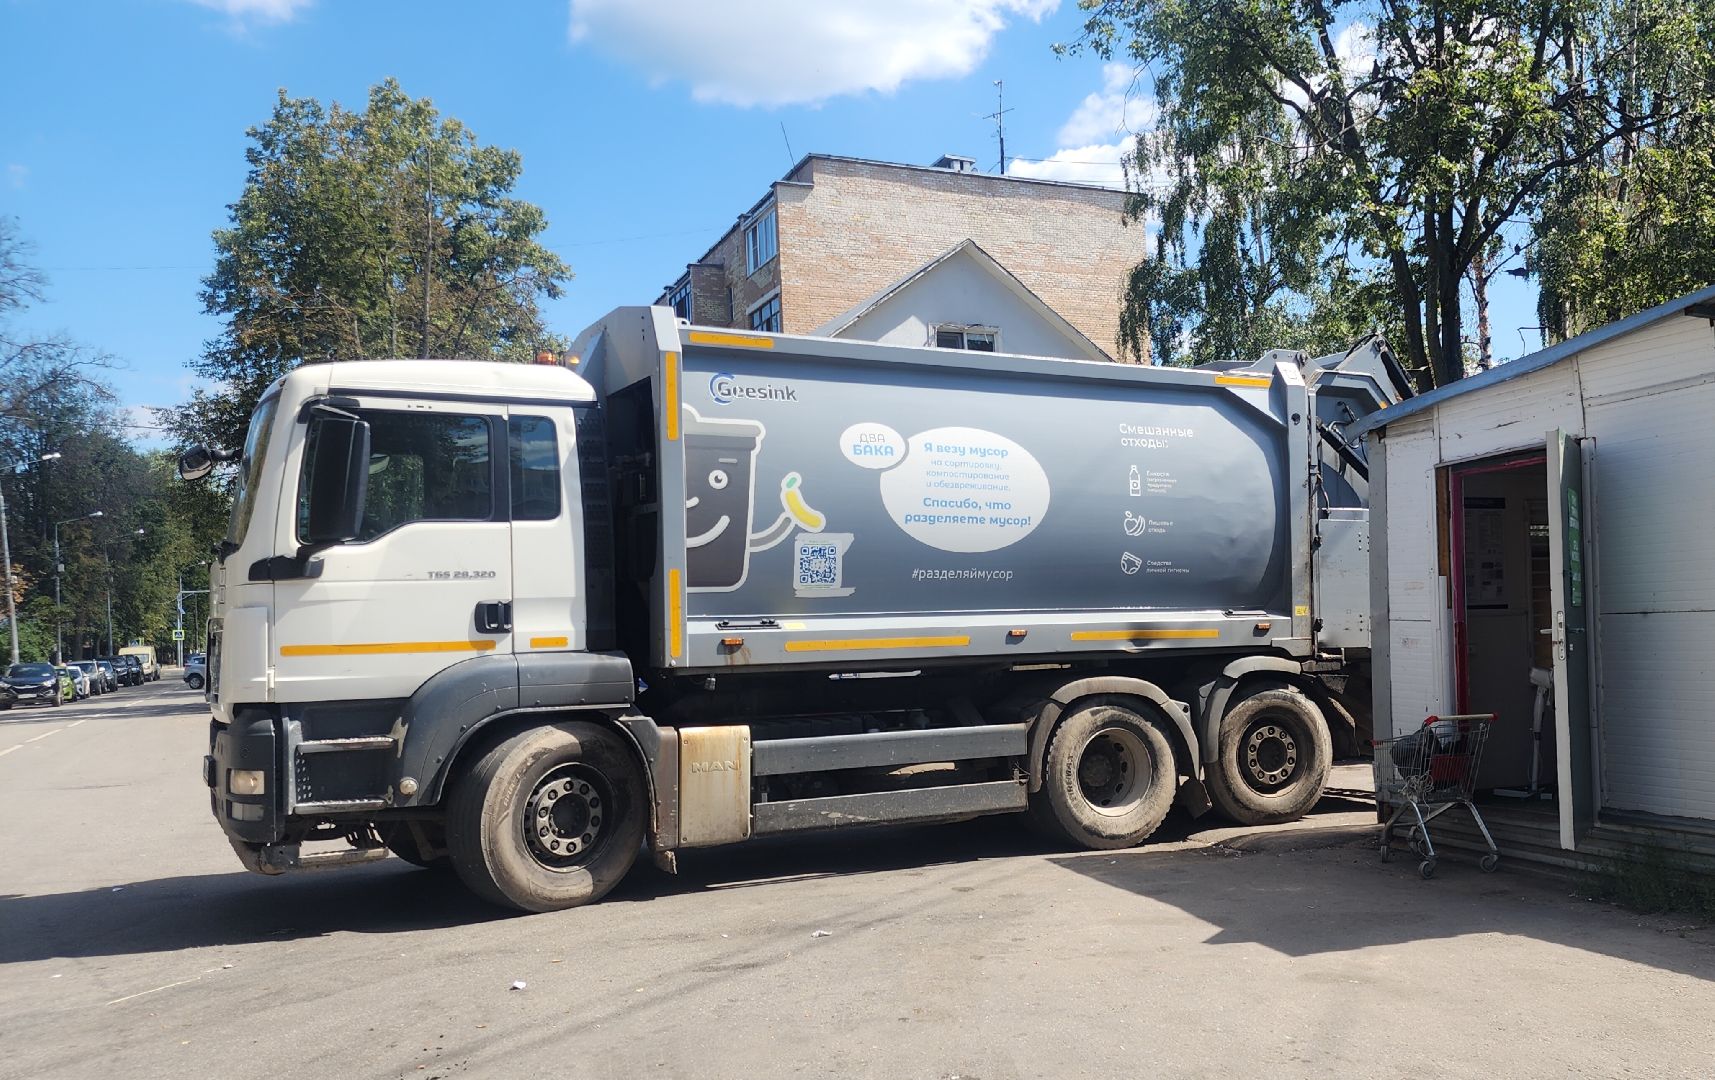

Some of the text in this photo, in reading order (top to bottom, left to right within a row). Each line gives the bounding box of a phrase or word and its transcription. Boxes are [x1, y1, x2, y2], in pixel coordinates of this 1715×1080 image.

[717, 381, 798, 402] Geesink
[1119, 423, 1194, 438] Смешанные
[859, 433, 886, 444] ДВА
[853, 444, 894, 457] БАКА
[924, 442, 1009, 459] Я везу мусор
[923, 497, 1012, 511] Спасибо, что
[904, 514, 1031, 528] разделяете мусор!
[912, 568, 1013, 582] #разделяймусор
[691, 760, 739, 774] MAN
